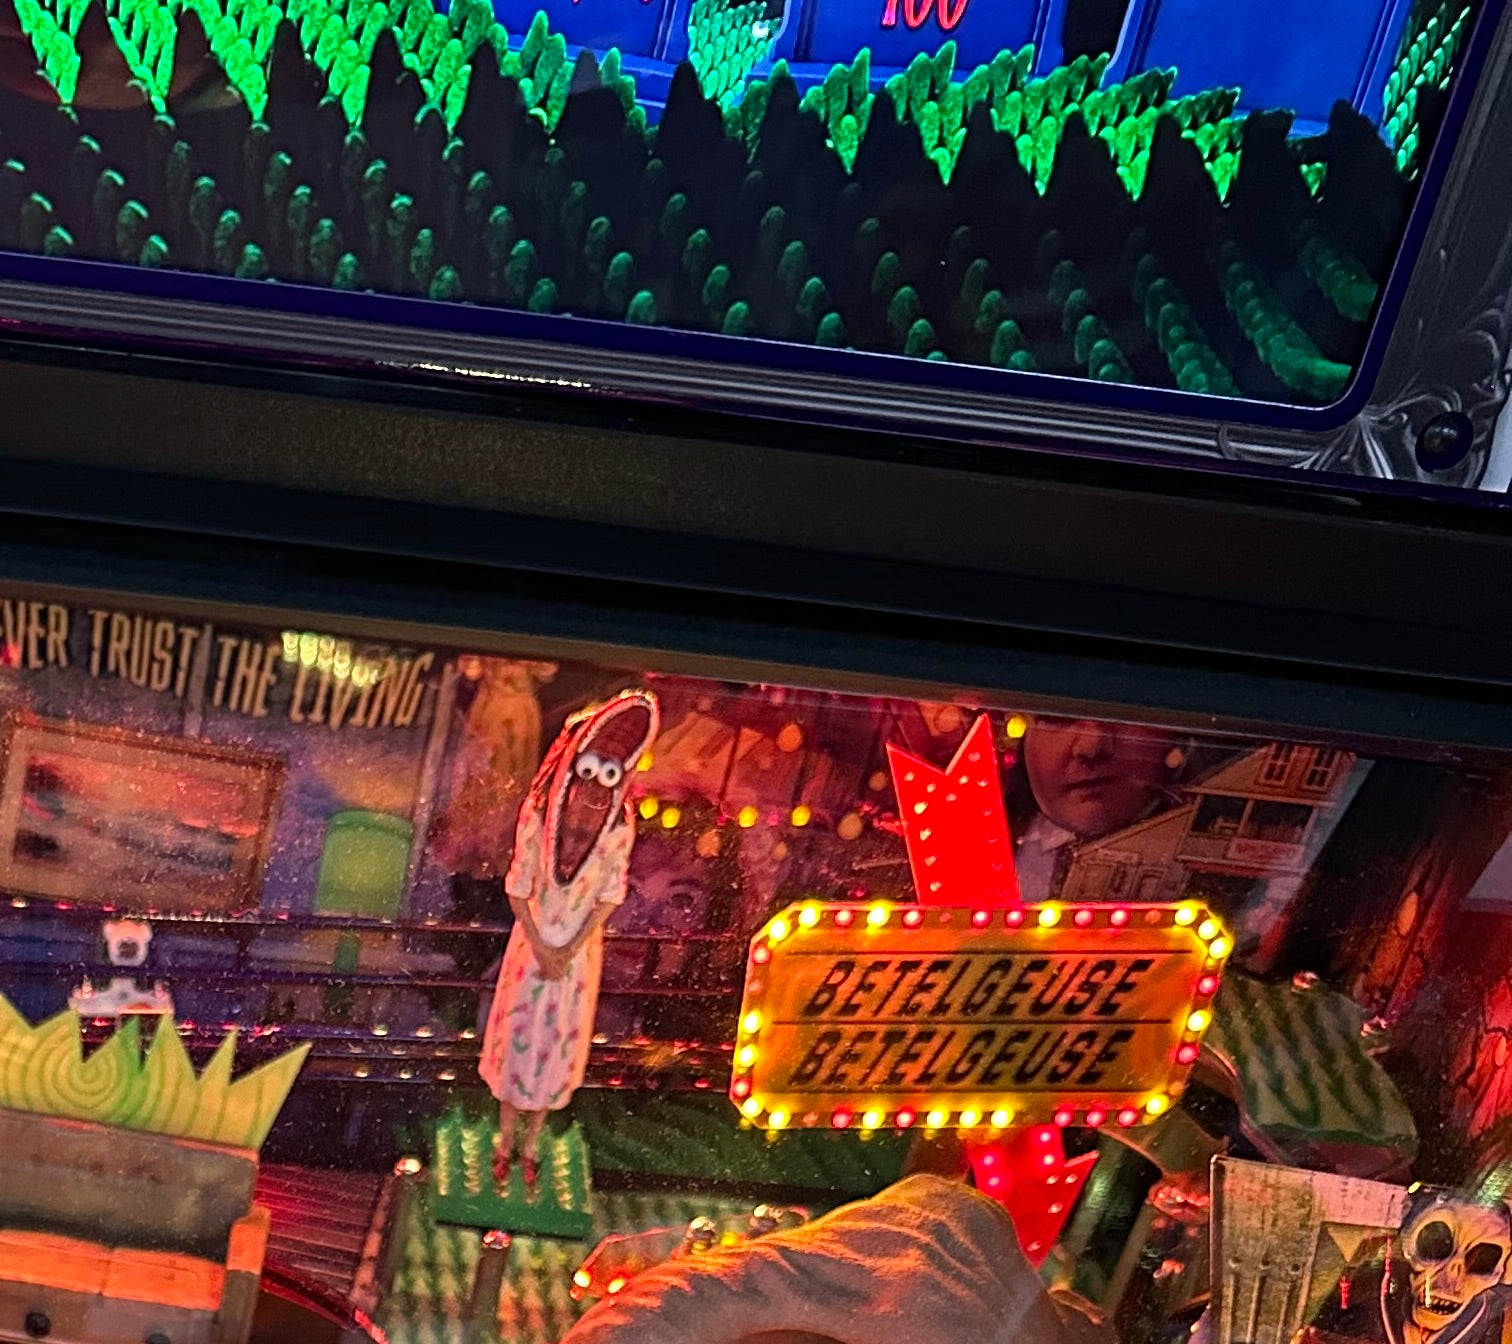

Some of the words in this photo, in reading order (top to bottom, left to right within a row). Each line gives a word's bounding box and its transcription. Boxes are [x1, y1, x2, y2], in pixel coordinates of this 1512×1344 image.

[89, 609, 198, 698] TRUST
[214, 635, 282, 718] THE
[801, 958, 1155, 1019] BETELGEUSE
[790, 1028, 1136, 1086] BETELGEUSE
